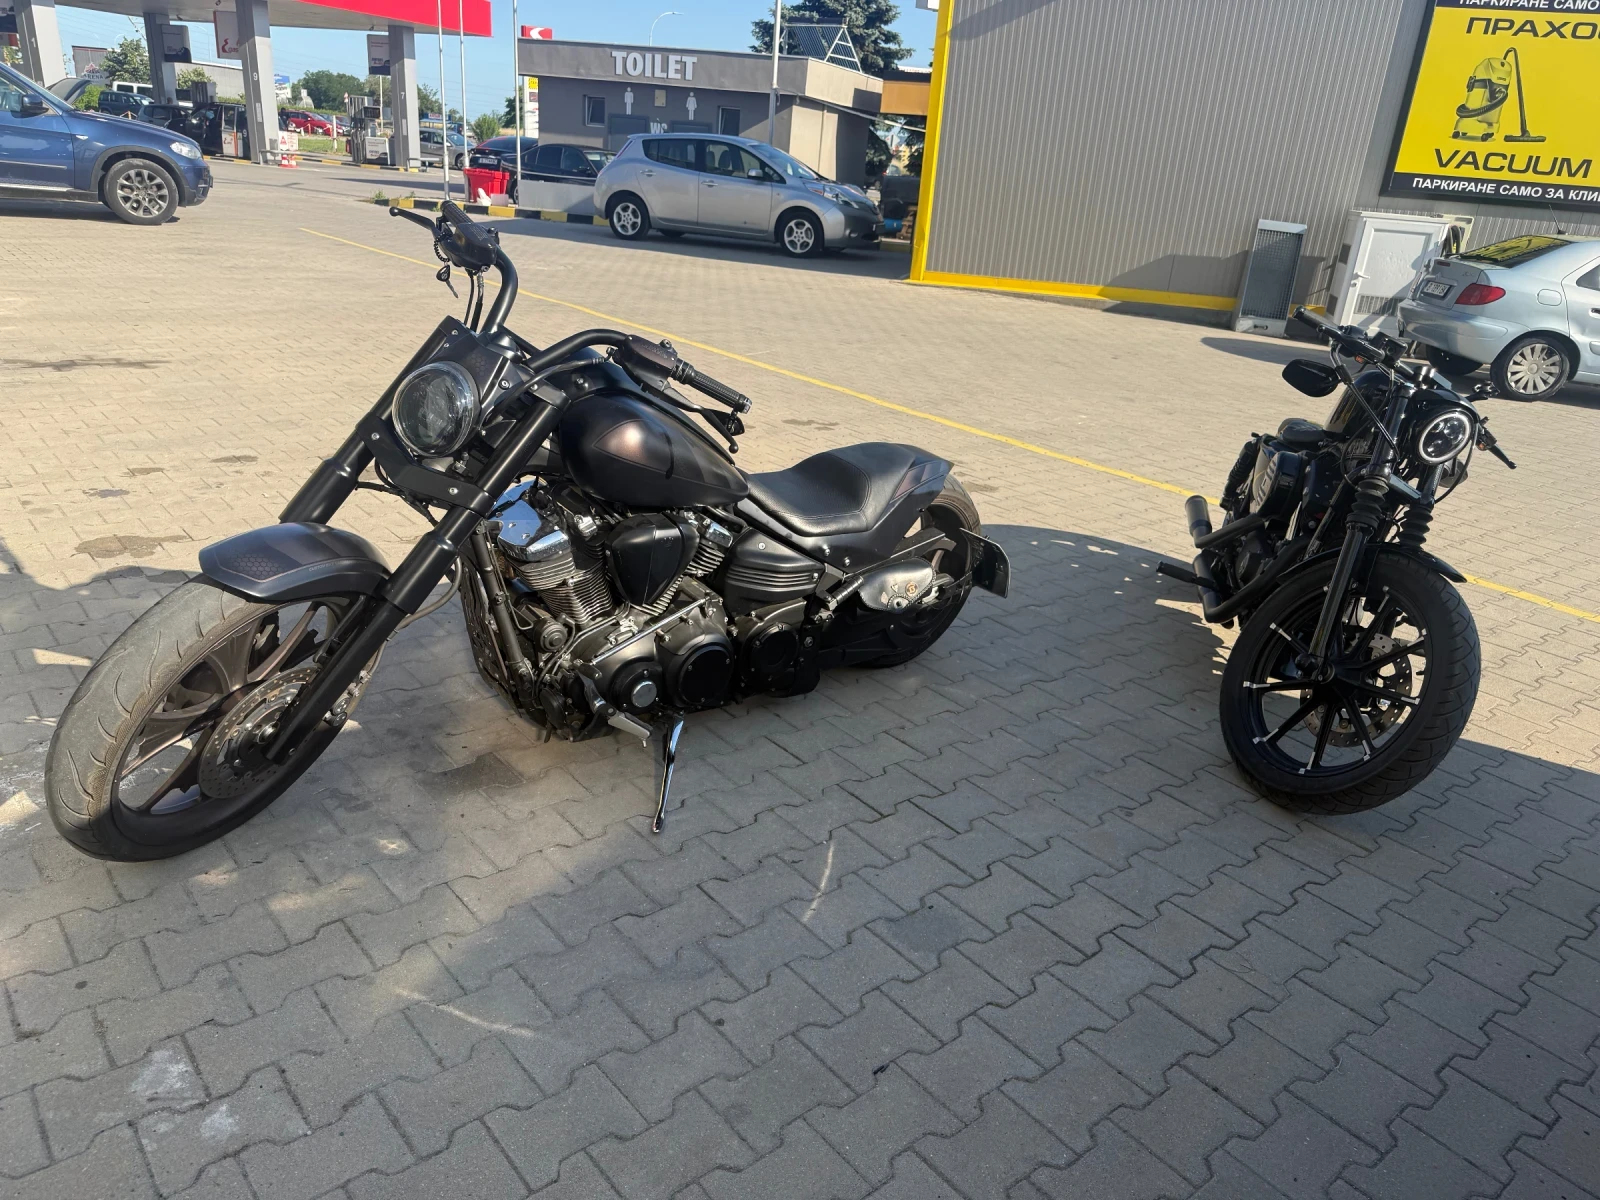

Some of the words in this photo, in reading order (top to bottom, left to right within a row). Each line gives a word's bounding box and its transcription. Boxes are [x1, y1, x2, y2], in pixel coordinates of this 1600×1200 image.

[1553, 0, 1600, 11] САМО
[1466, 16, 1600, 40] ПРАХО
[253, 72, 258, 81] 9
[611, 50, 698, 81] TOILET
[1434, 148, 1593, 178] VACUUM
[1412, 177, 1497, 195] ПАРКИРАНЕ
[1499, 184, 1543, 199] САМО
[1545, 187, 1565, 200] ЗА
